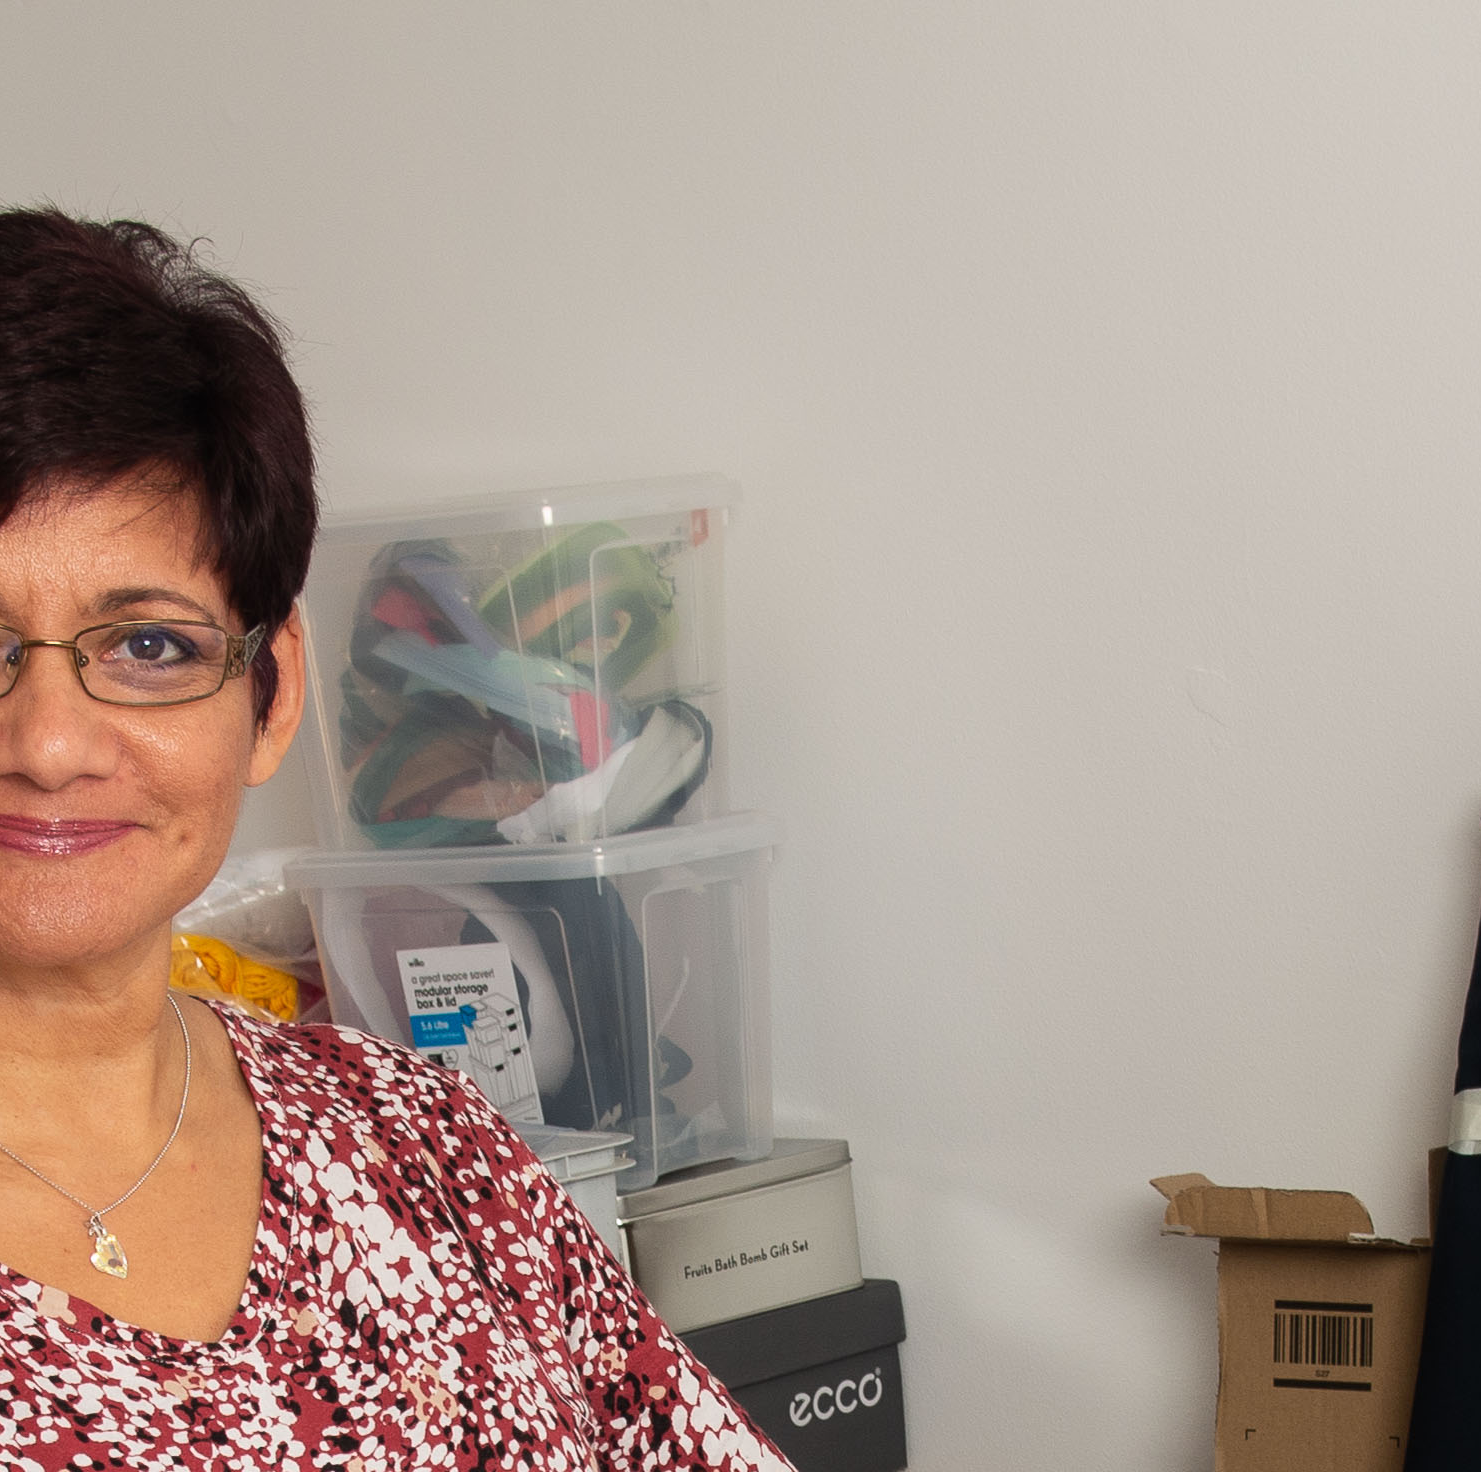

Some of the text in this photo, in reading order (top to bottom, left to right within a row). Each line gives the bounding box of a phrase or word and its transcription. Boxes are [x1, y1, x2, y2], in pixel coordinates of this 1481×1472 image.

[408, 958, 424, 967] wilko
[411, 968, 495, 986] a great space saver!
[414, 983, 489, 998] modular storage
[416, 996, 457, 1009] box & lid
[684, 1240, 809, 1279] Fruits Bath Bomb Gift Set
[789, 1373, 883, 1427] ecco
